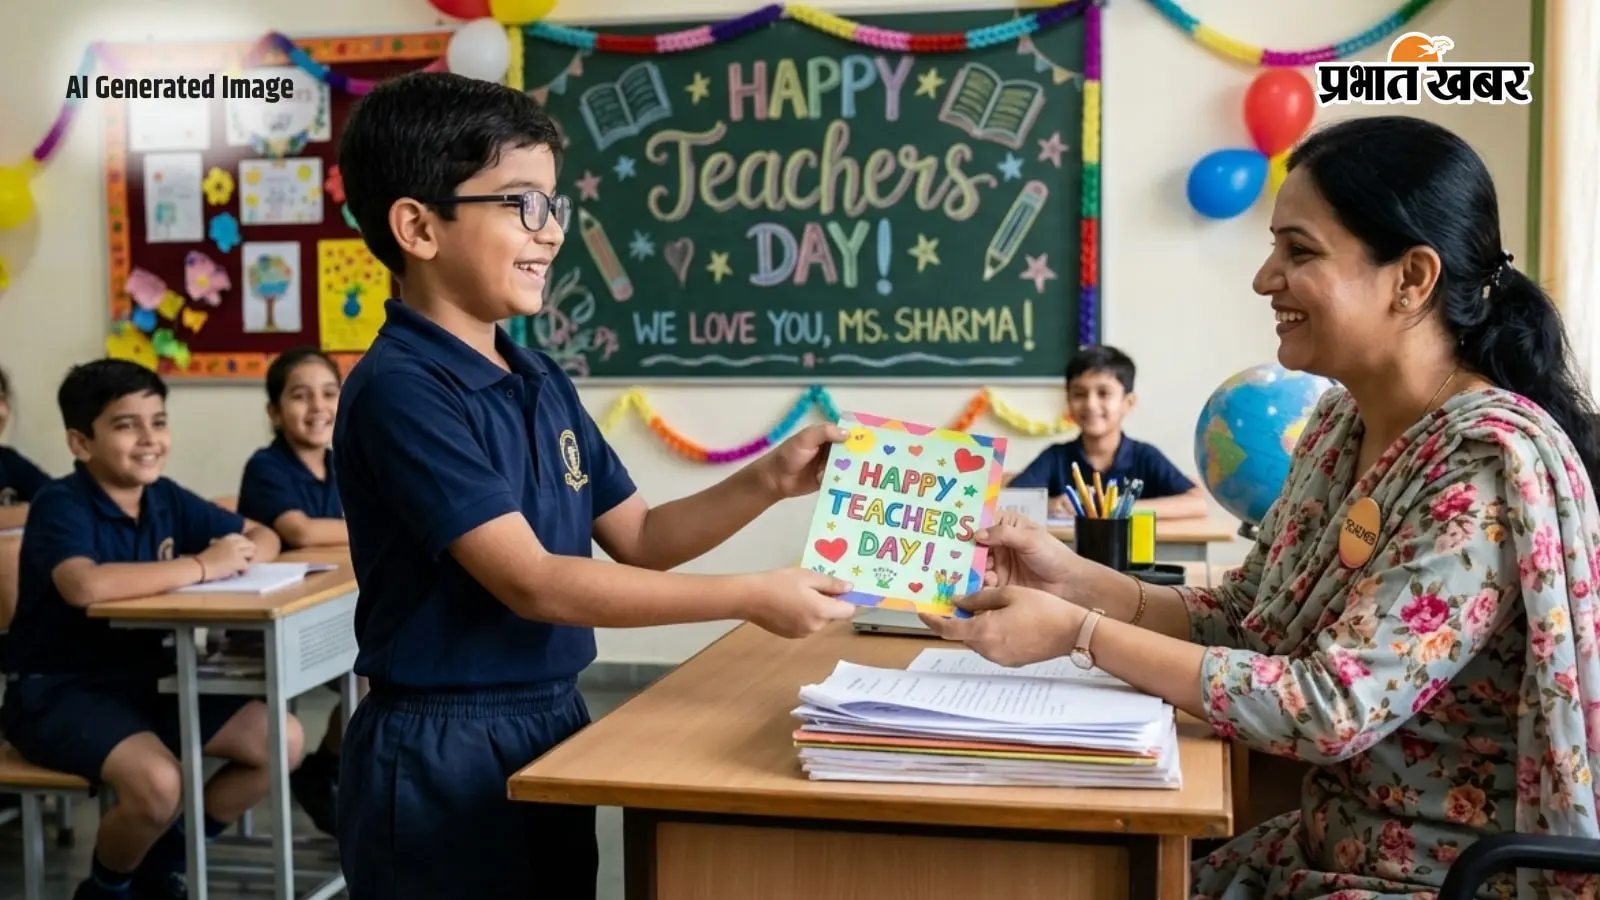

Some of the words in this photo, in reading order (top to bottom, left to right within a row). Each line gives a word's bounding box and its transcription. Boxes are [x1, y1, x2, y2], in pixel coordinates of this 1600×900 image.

[727, 54, 915, 122] HAPPY
[645, 119, 998, 222] Teachers
[746, 217, 894, 296] DAY!
[632, 311, 676, 345] WE
[688, 311, 757, 345] LOVE
[767, 311, 832, 349] YOU,
[837, 307, 889, 345] MS.
[858, 461, 957, 503] HAPPY
[828, 488, 976, 543] TEACHERS
